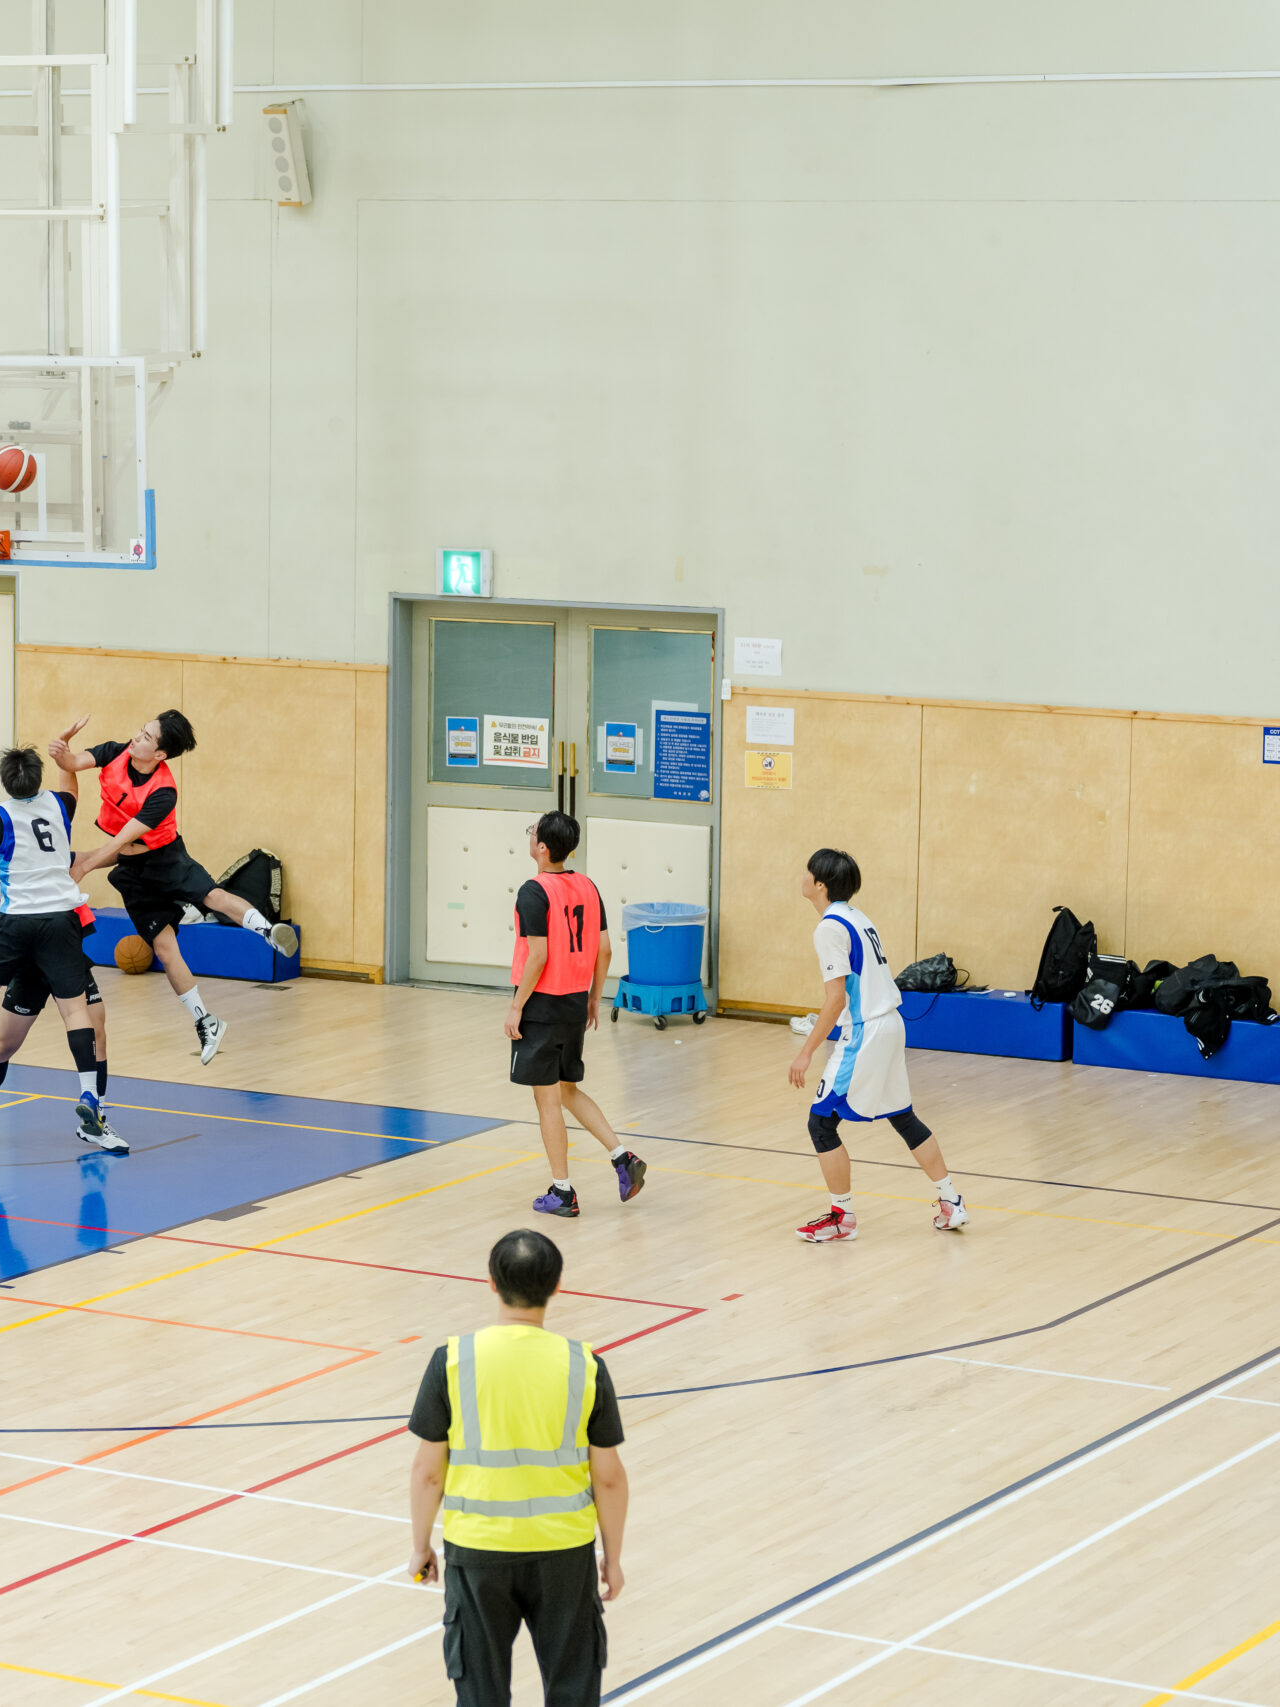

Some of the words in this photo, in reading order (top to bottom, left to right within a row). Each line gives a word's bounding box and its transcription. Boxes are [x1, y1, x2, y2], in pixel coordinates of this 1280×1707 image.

[493, 732, 519, 744] 음식물
[521, 734, 538, 745] 반입
[493, 745, 502, 756] 및
[504, 746, 521, 757] 섭취
[523, 747, 540, 759] 금지
[116, 792, 128, 807] 1
[31, 817, 56, 852] 6
[564, 904, 584, 953] 11
[1090, 994, 1114, 1015] 26
